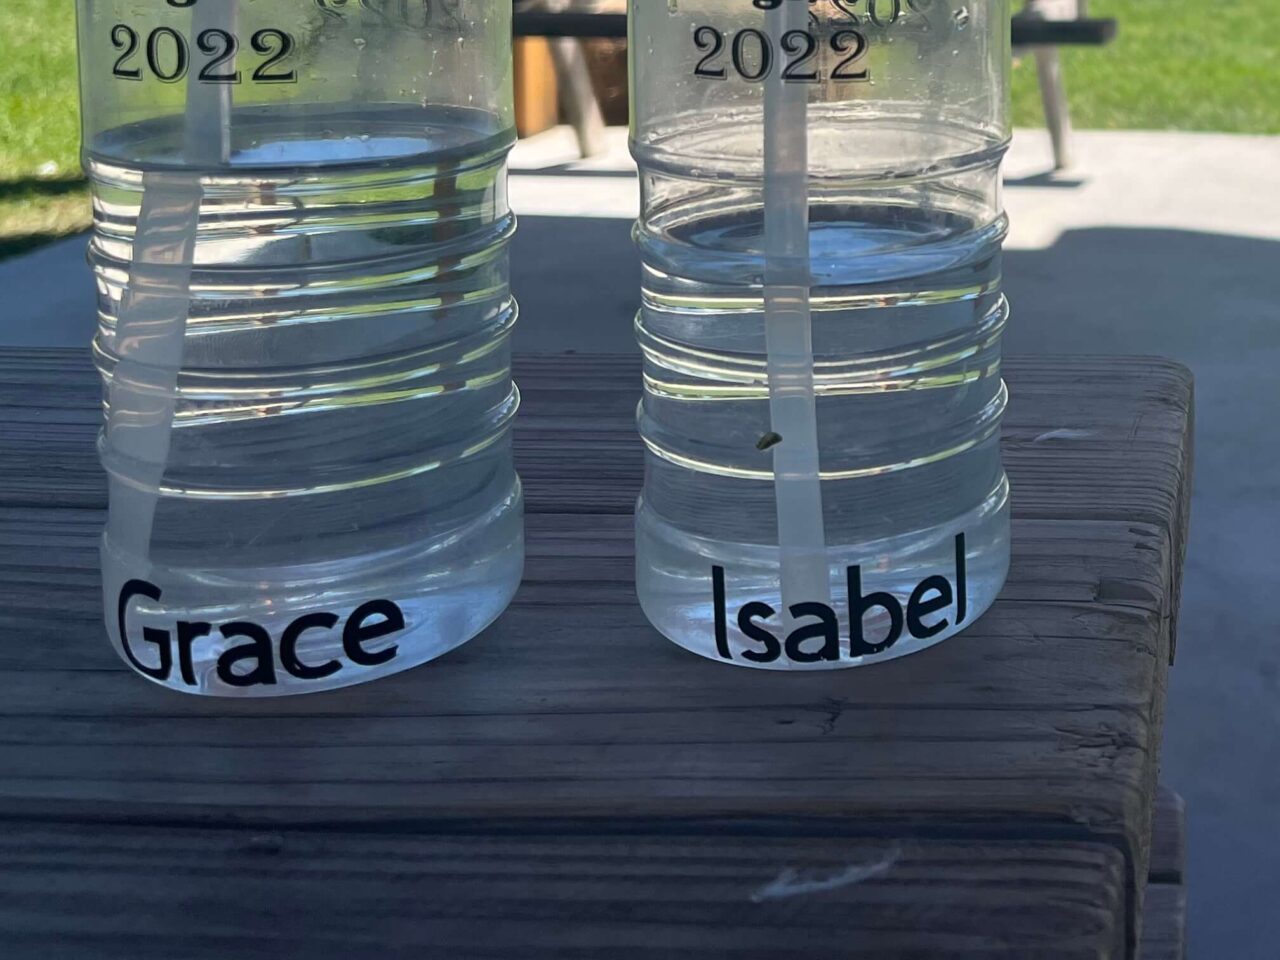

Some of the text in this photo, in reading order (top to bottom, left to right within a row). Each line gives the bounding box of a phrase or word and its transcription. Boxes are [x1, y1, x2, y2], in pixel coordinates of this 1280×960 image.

[110, 24, 298, 85] 2022
[692, 25, 870, 84] 2022
[118, 578, 405, 687] Grace
[711, 531, 967, 663] Isabel
